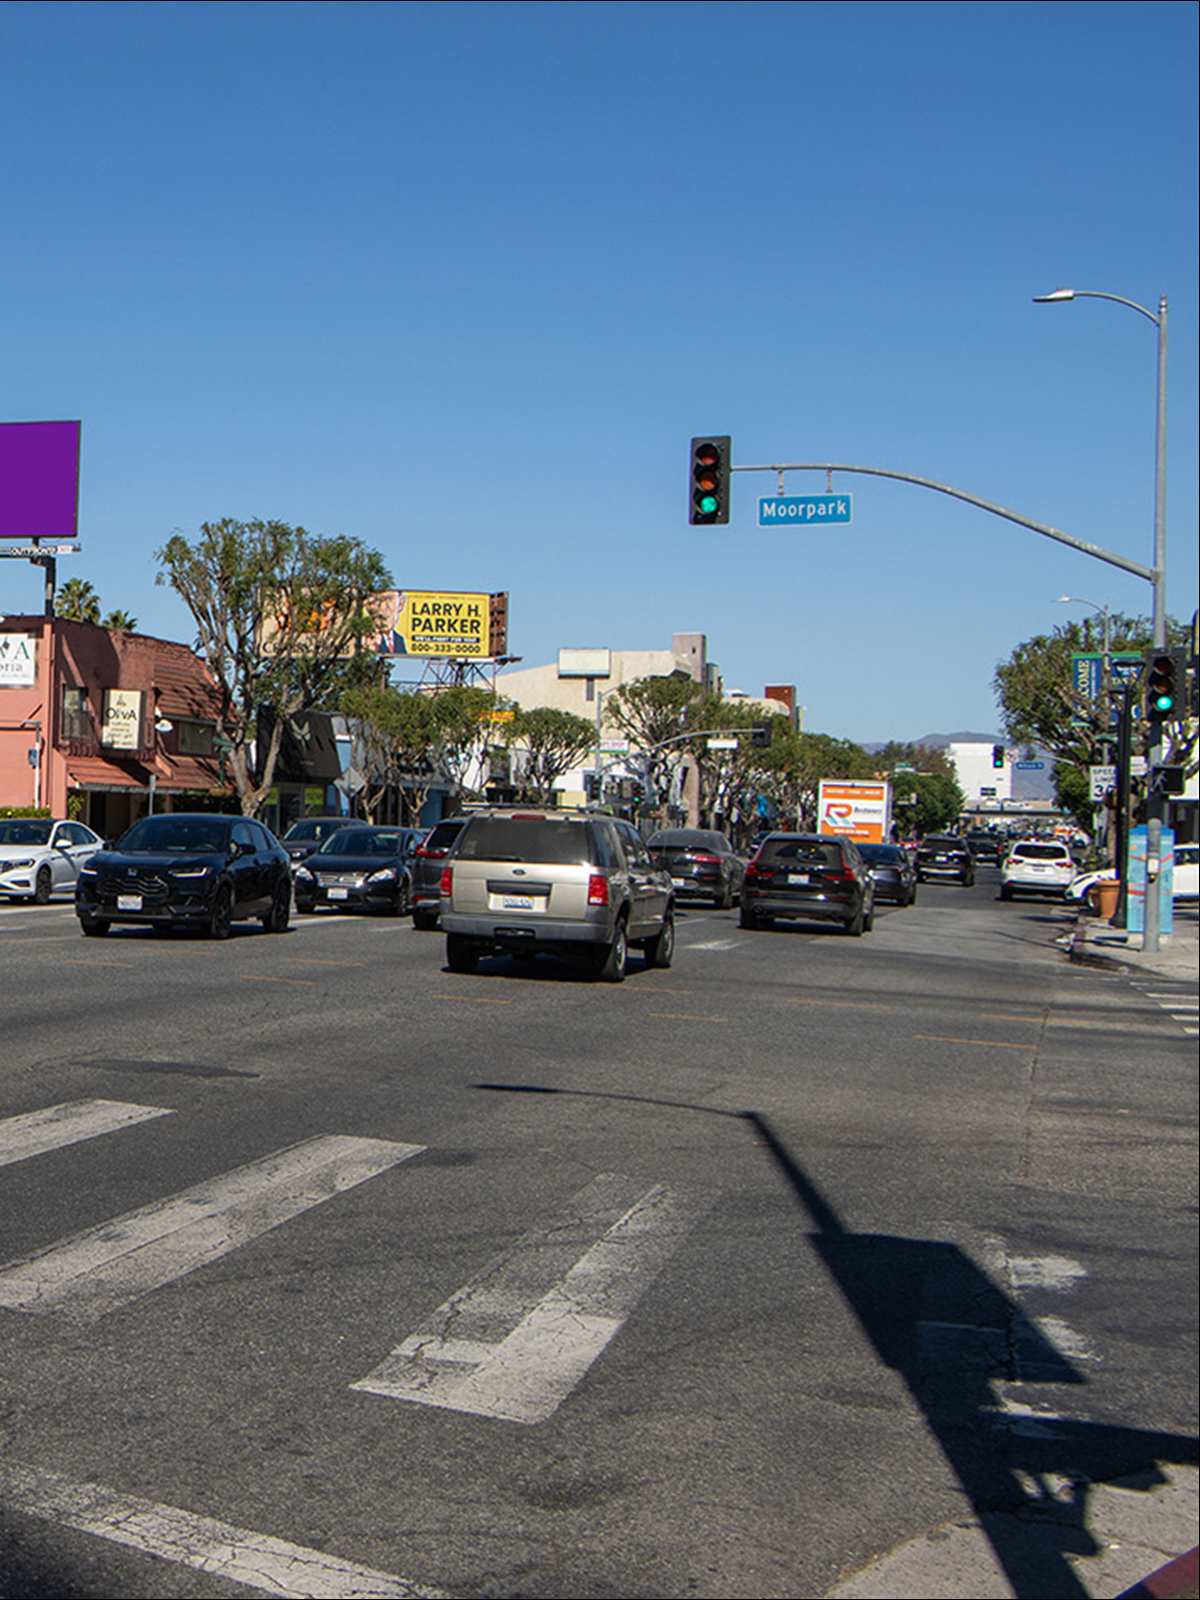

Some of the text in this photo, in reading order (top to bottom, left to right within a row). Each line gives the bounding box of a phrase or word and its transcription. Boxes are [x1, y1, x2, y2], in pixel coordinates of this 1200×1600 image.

[763, 500, 846, 519] Moorpark
[412, 602, 481, 617] LARRY H.
[412, 617, 481, 634] PARKER
[411, 643, 481, 654] 800-333-0000
